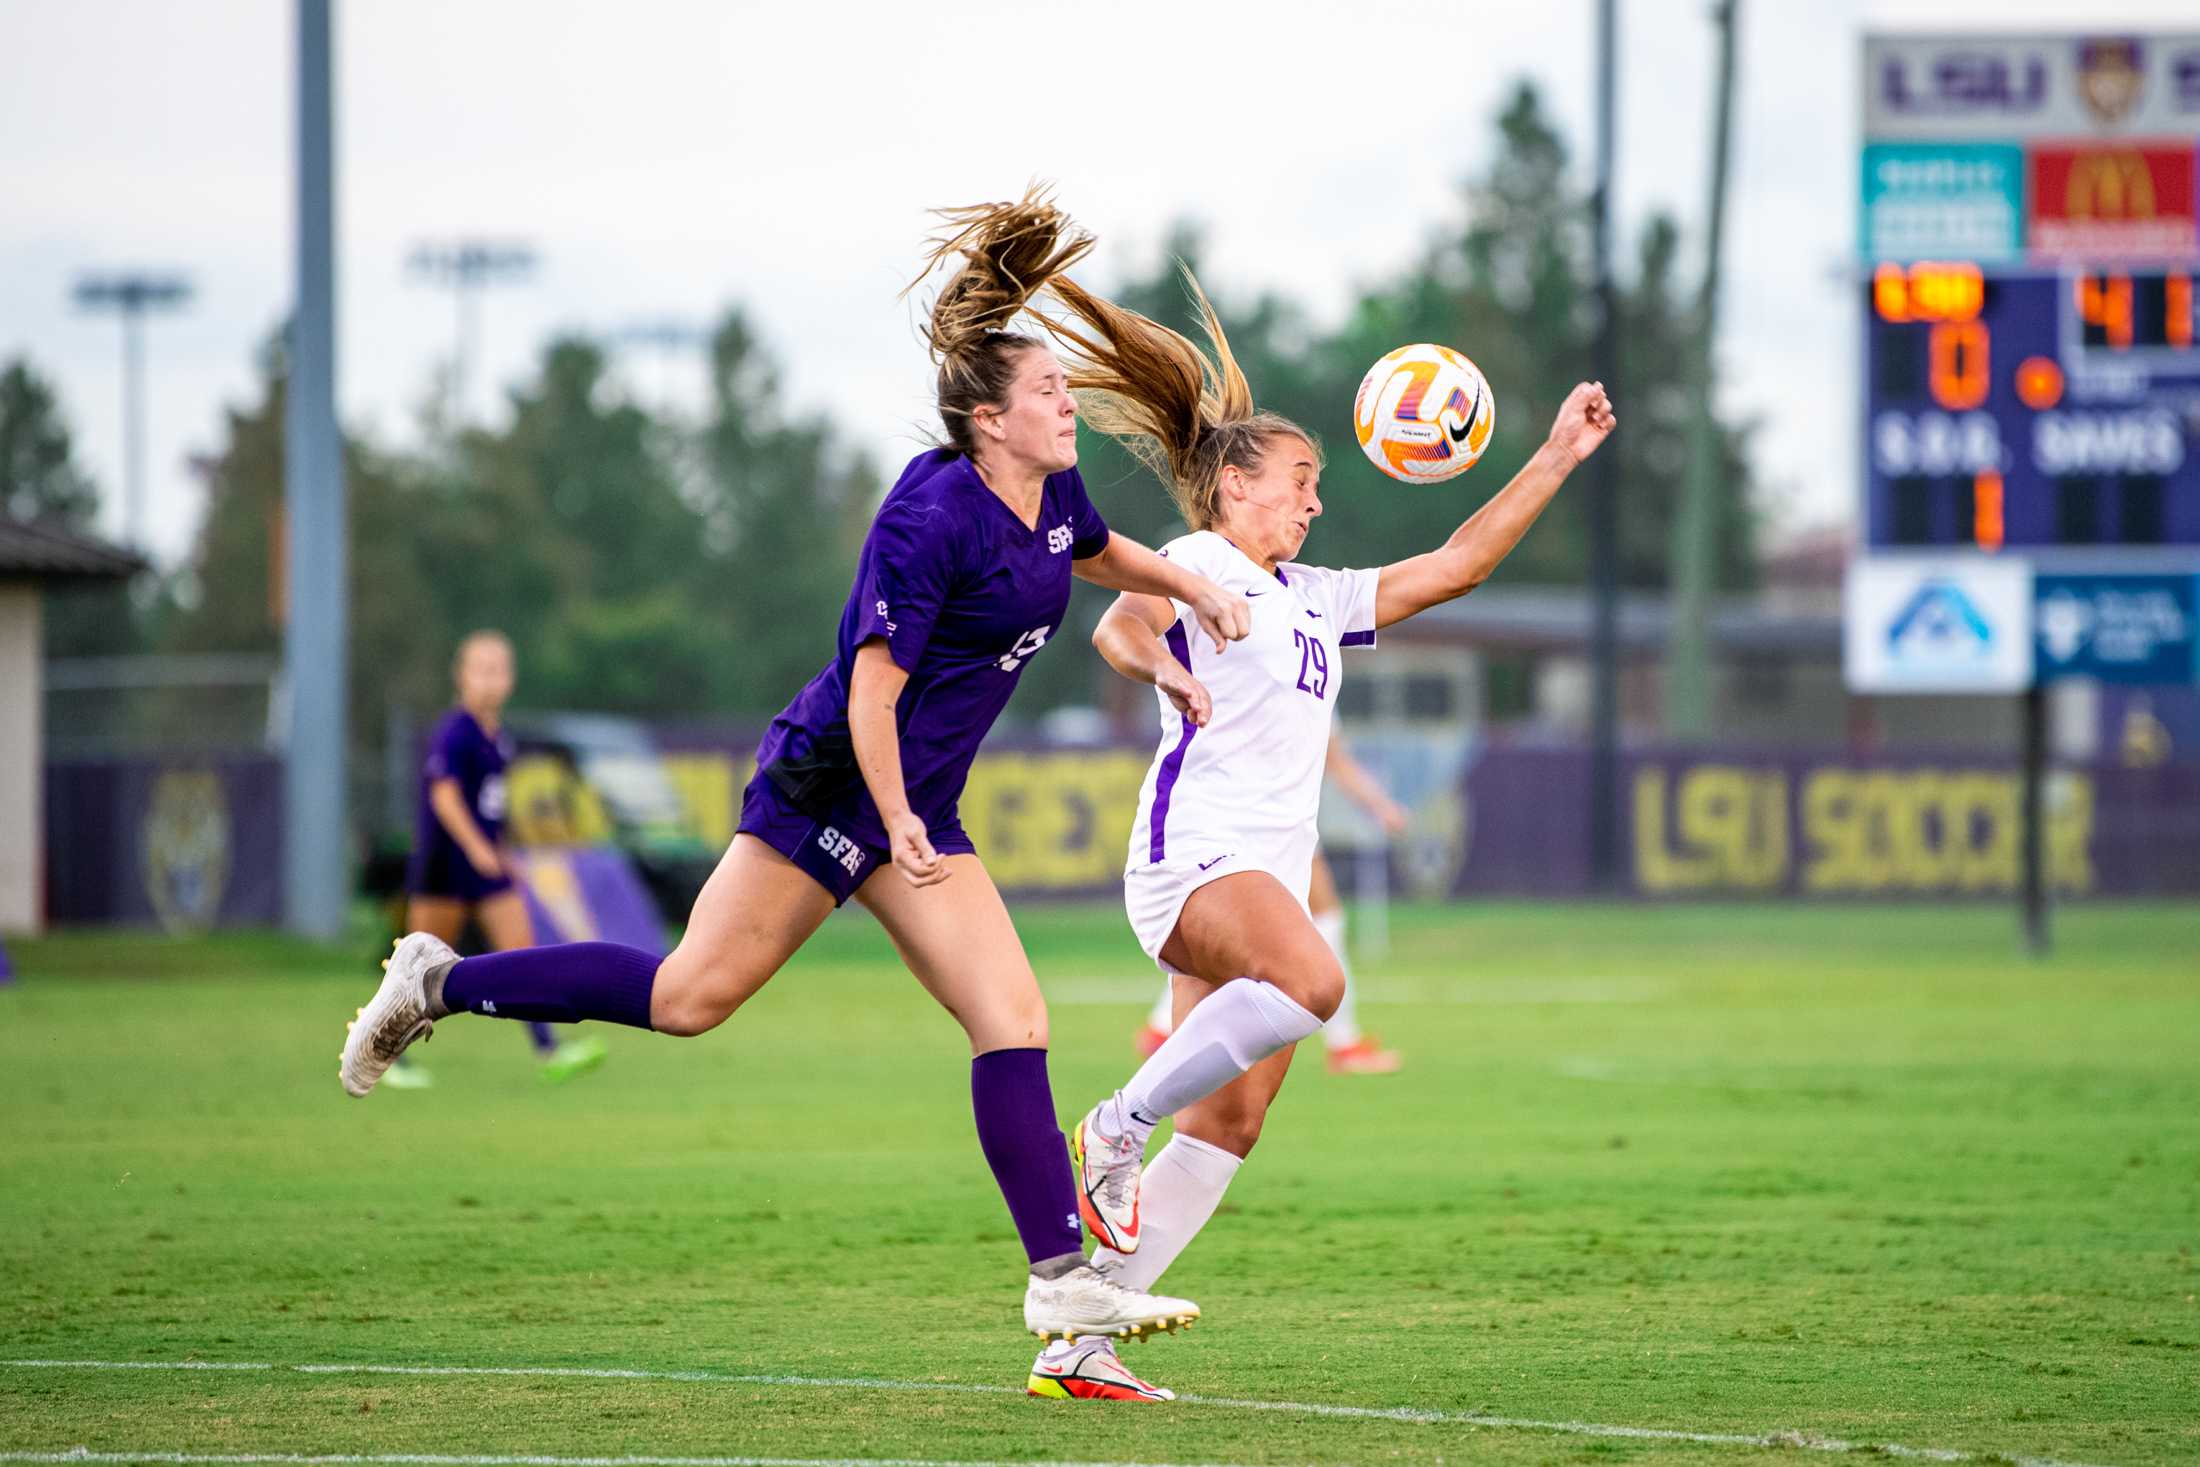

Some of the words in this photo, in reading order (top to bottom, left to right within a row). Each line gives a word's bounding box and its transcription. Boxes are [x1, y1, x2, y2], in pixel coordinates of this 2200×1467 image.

[1294, 628, 1329, 700] 29
[818, 826, 861, 877] SFA
[1635, 767, 1790, 891] LSU
